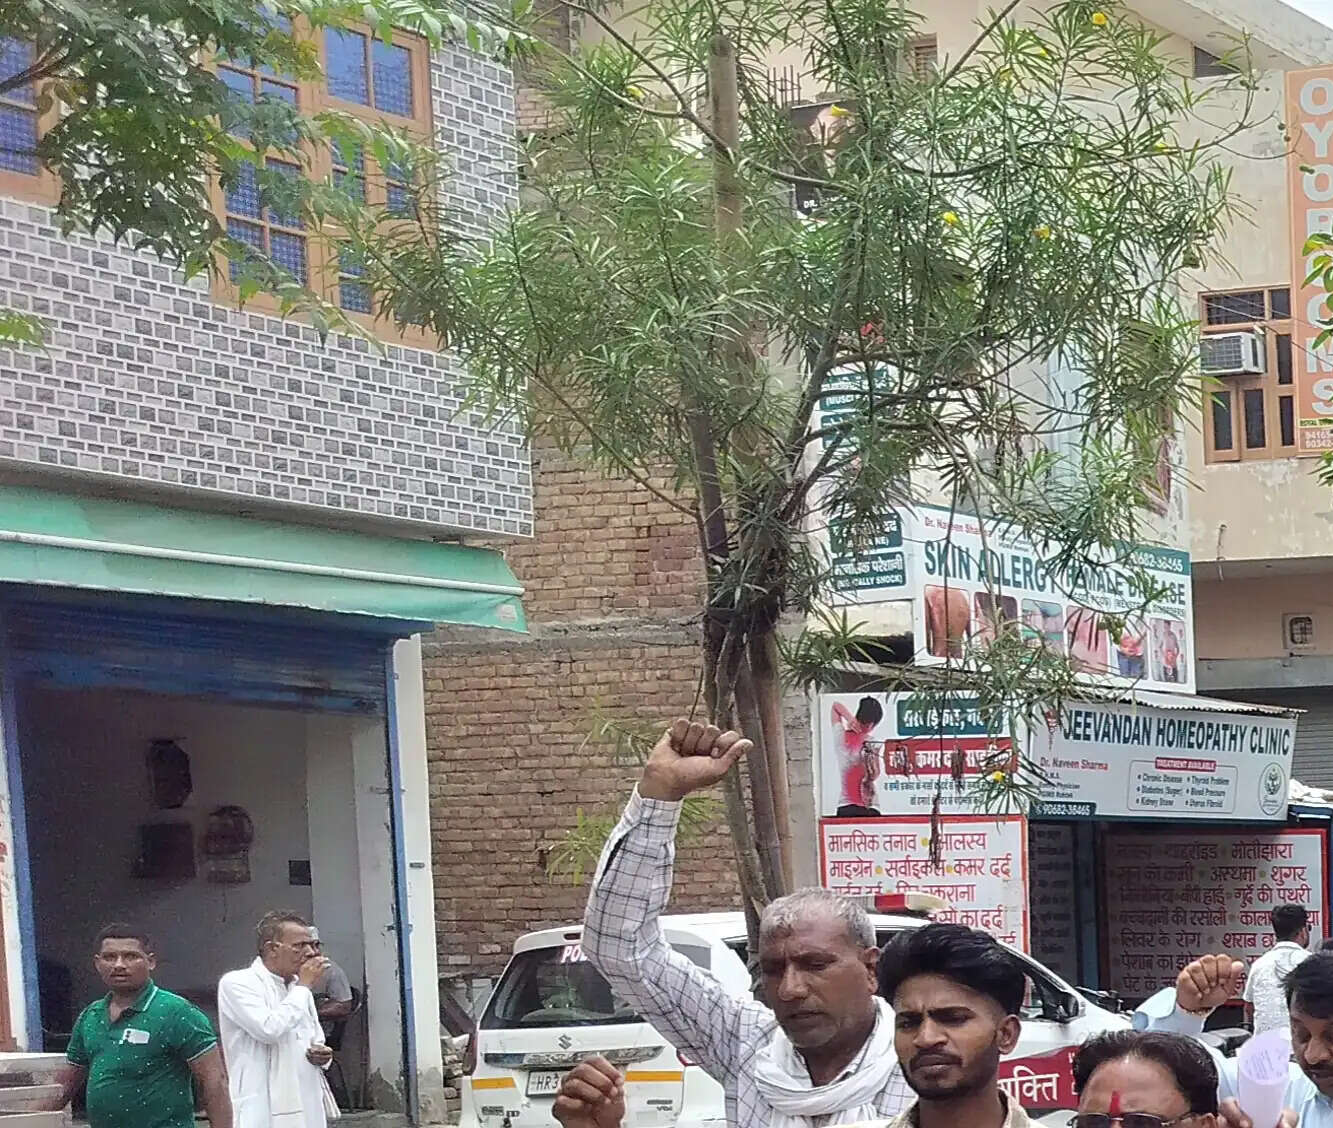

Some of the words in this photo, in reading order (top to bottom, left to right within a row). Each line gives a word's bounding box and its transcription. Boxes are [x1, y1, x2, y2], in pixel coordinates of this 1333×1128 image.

[925, 540, 971, 580] SKIN
[1063, 709, 1152, 748] JEEVANDAN
[1156, 717, 1248, 754] HOMEOPATHY
[1249, 725, 1291, 757] CLINIC
[1081, 759, 1109, 771] Sharma
[828, 829, 879, 853] मानसिक
[882, 834, 917, 853] तनाव
[829, 857, 873, 879] माइग्रेन
[953, 860, 985, 876] कमर
[990, 854, 1012, 878] दर्द
[1271, 865, 1307, 886] शुगर
[1277, 884, 1312, 903] पथरी
